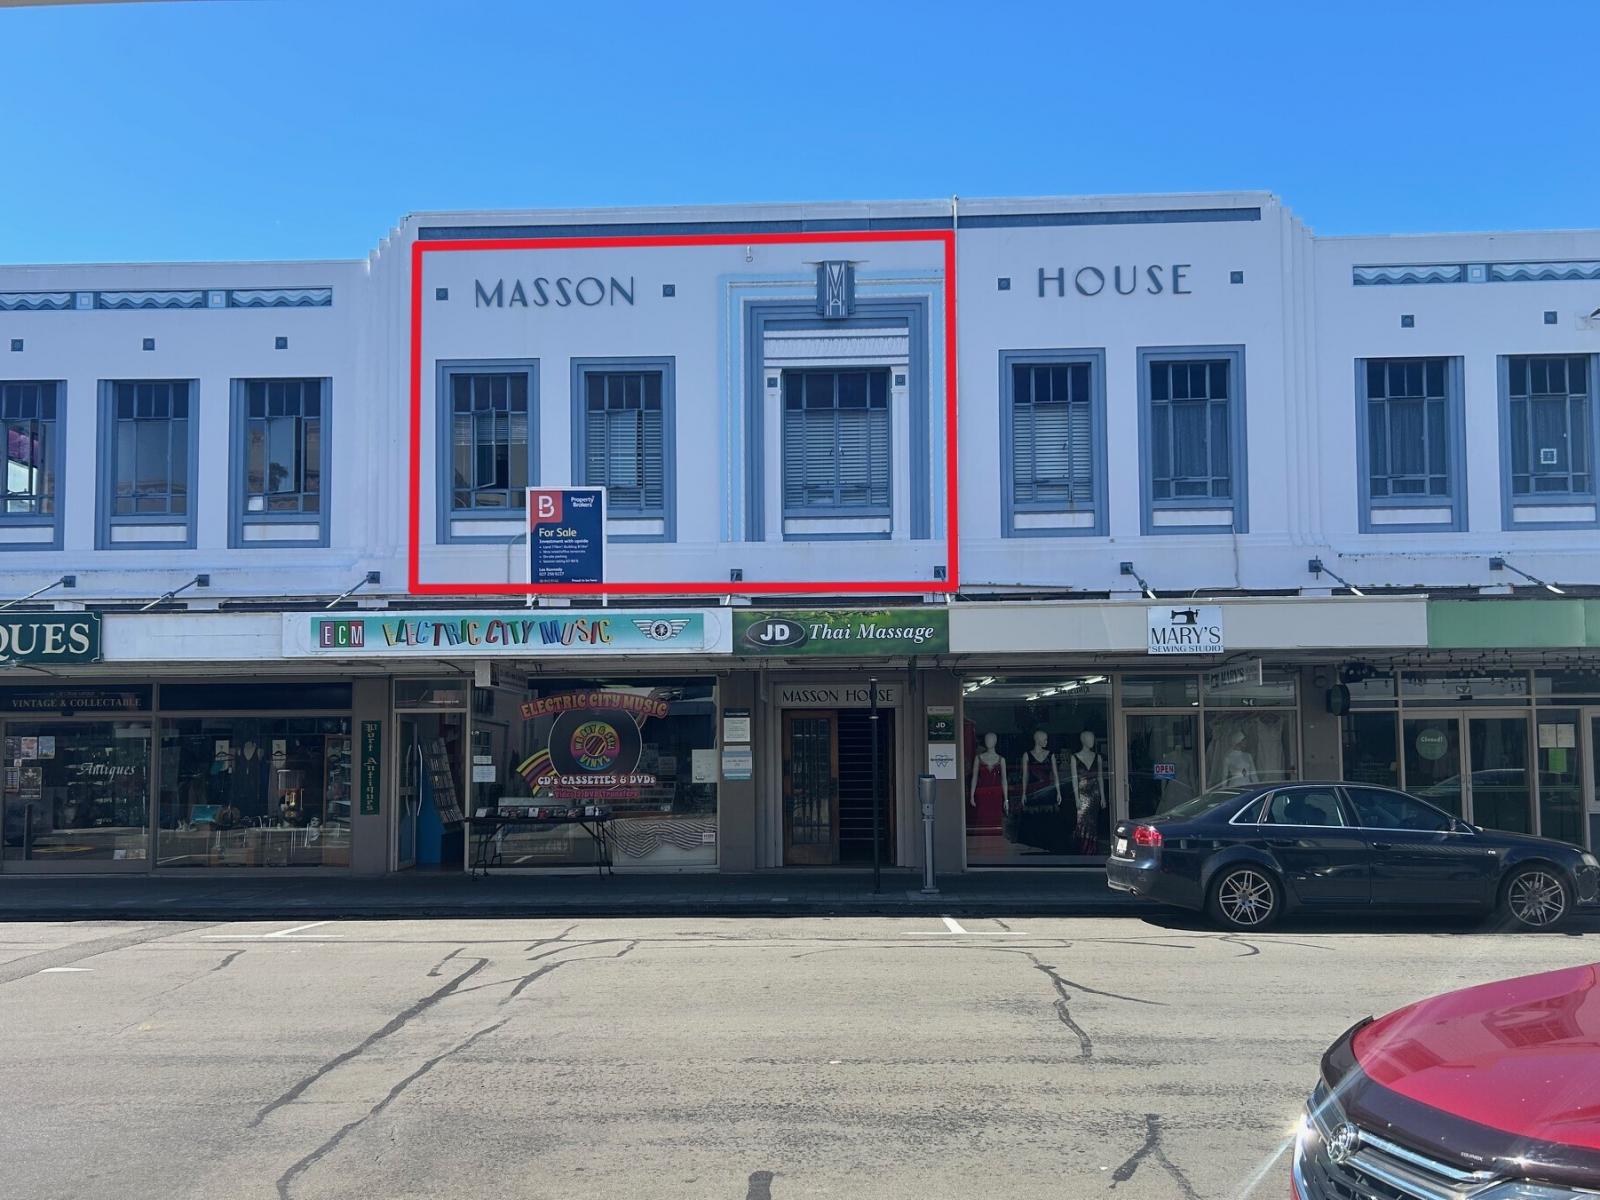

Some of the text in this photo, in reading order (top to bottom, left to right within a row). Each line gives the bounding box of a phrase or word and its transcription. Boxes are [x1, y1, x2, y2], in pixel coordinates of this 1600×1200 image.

[474, 264, 1192, 308] MASSON HOUSE
[538, 528, 577, 537] For Sale
[324, 625, 363, 645] ECM
[383, 617, 613, 646] ELECTRIC CITY MUSIC
[759, 624, 790, 641] JD
[809, 623, 934, 643] Thai Massage
[1151, 626, 1221, 645] MARY'S
[12, 699, 57, 708] VINTAGE
[782, 689, 894, 703] MASSON HOSE
[521, 693, 668, 718] ELECTRIC CITY MUSIC
[579, 754, 611, 768] VINYL
[1155, 765, 1174, 773] OPEN
[76, 762, 136, 783] Antiques
[537, 775, 656, 786] CD's CASSETTES & DVDs
